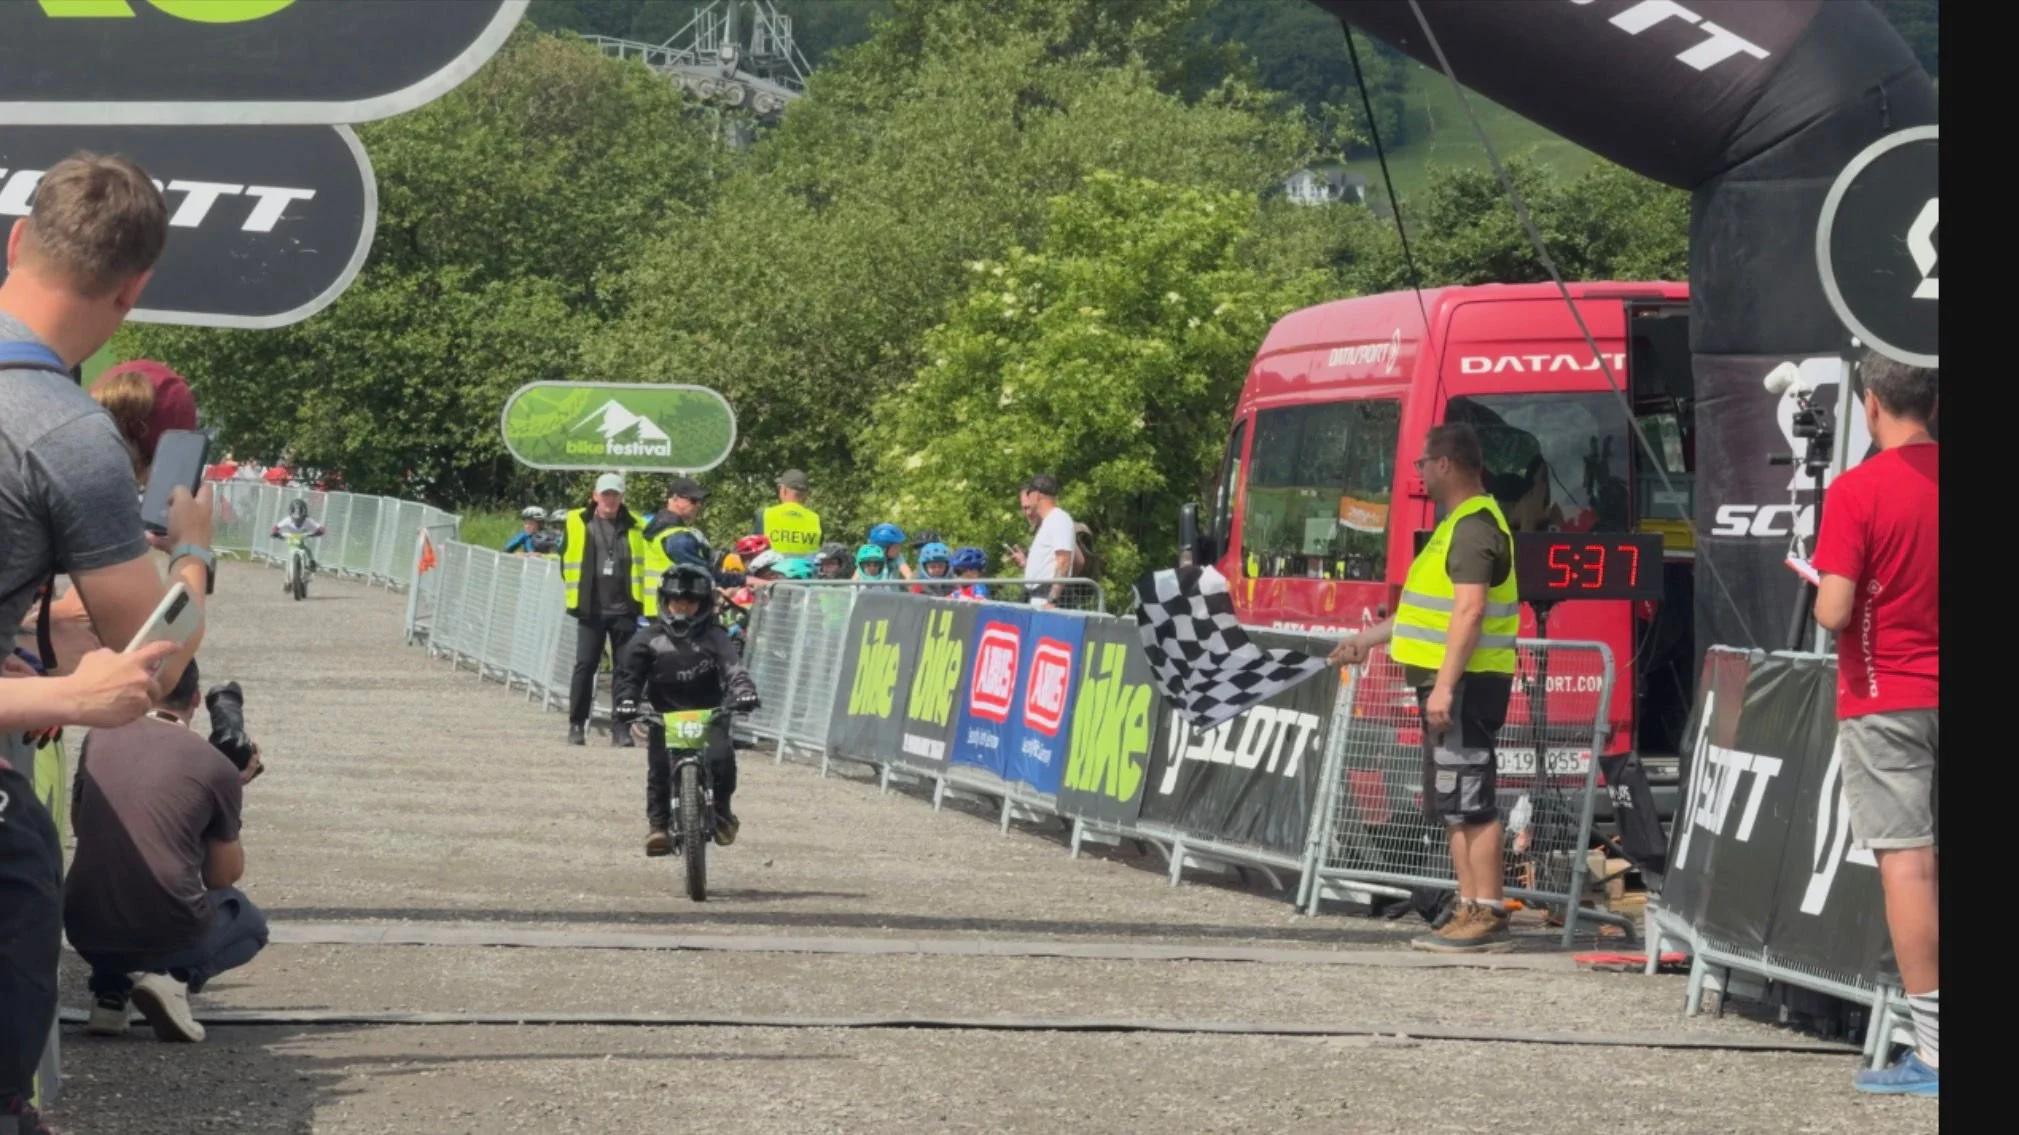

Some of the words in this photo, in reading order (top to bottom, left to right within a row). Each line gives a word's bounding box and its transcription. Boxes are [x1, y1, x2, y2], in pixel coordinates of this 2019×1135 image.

[606, 438, 671, 456] festival
[770, 529, 817, 544] CREW
[1548, 544, 1640, 588] 5:37
[848, 619, 900, 719] bike
[908, 608, 963, 727] bike
[976, 644, 1014, 699] ABUS
[1030, 659, 1066, 713] ABUS
[1064, 641, 1152, 802] bike
